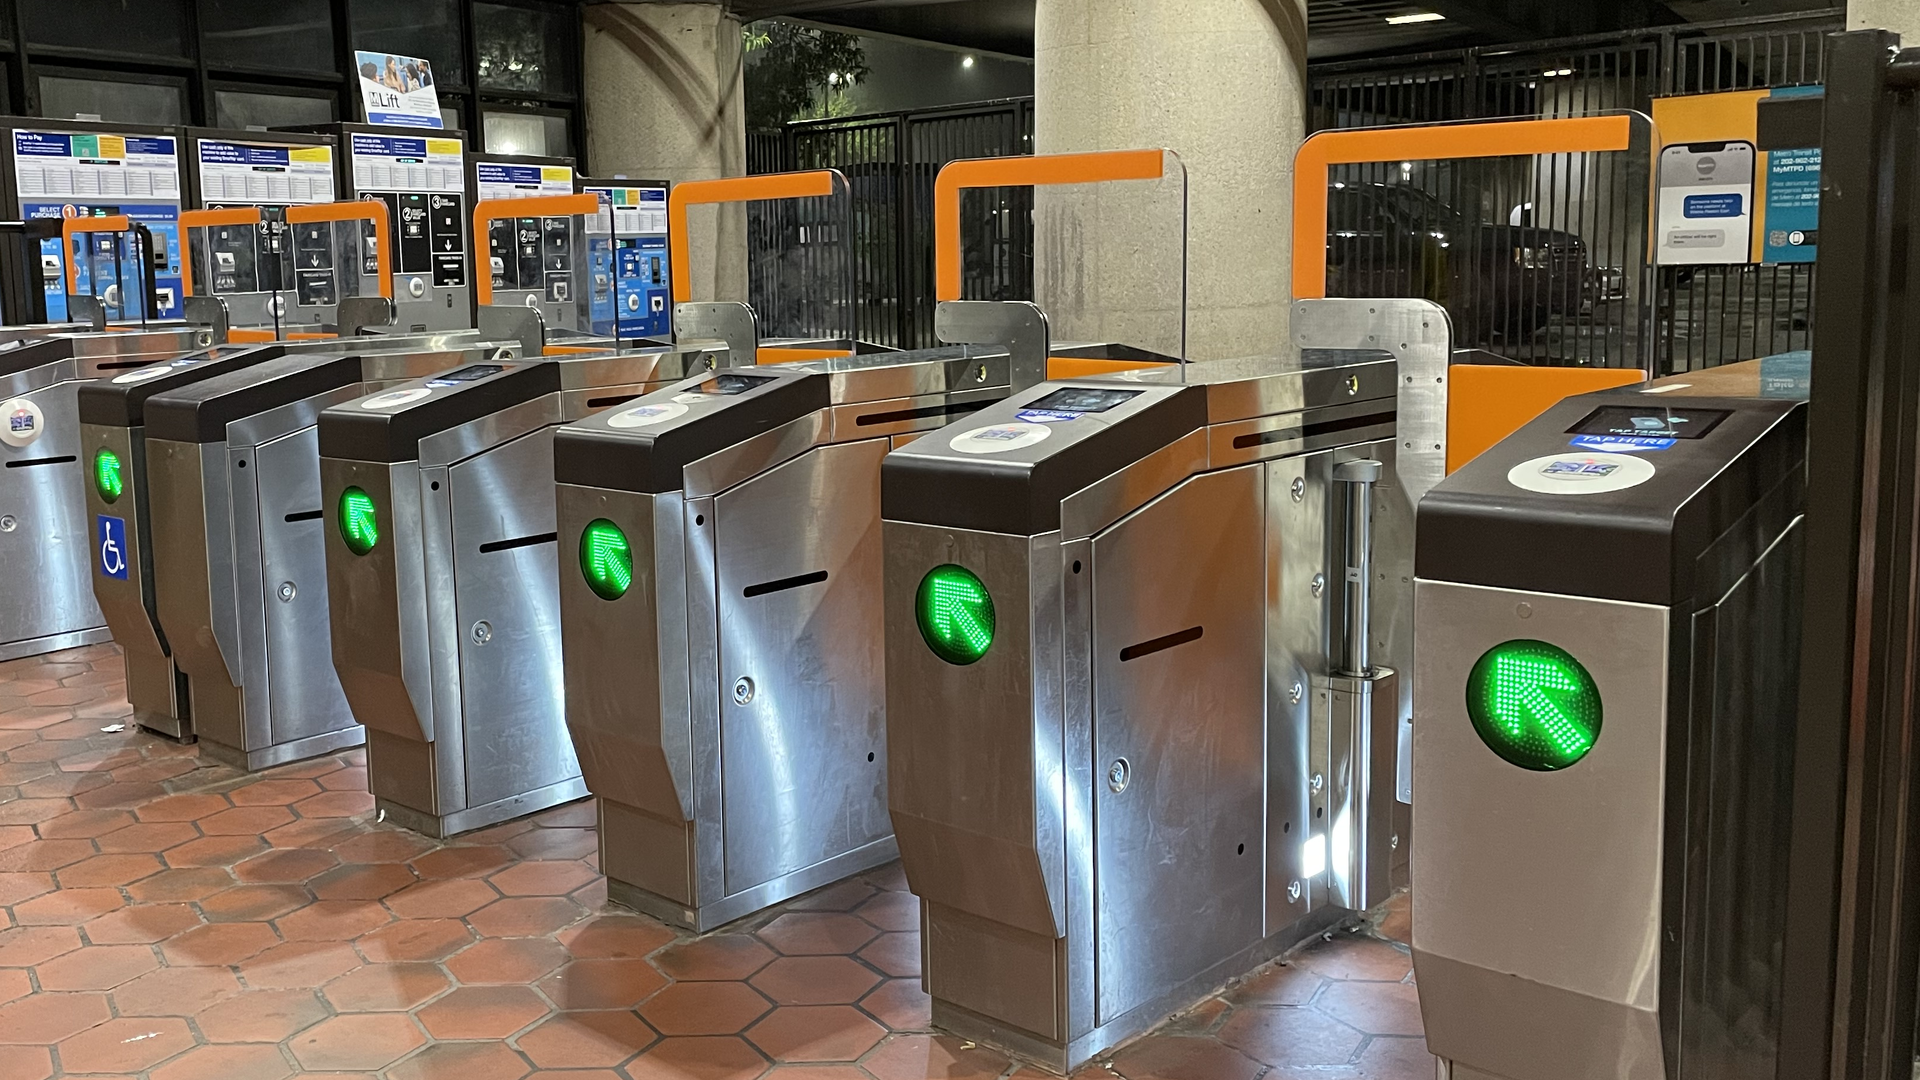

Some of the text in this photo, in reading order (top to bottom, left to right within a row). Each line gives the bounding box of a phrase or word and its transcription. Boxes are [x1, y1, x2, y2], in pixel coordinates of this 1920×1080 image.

[379, 92, 400, 109] Lift
[1773, 165, 1804, 173] MyMTPD
[1617, 437, 1671, 445] HERE
